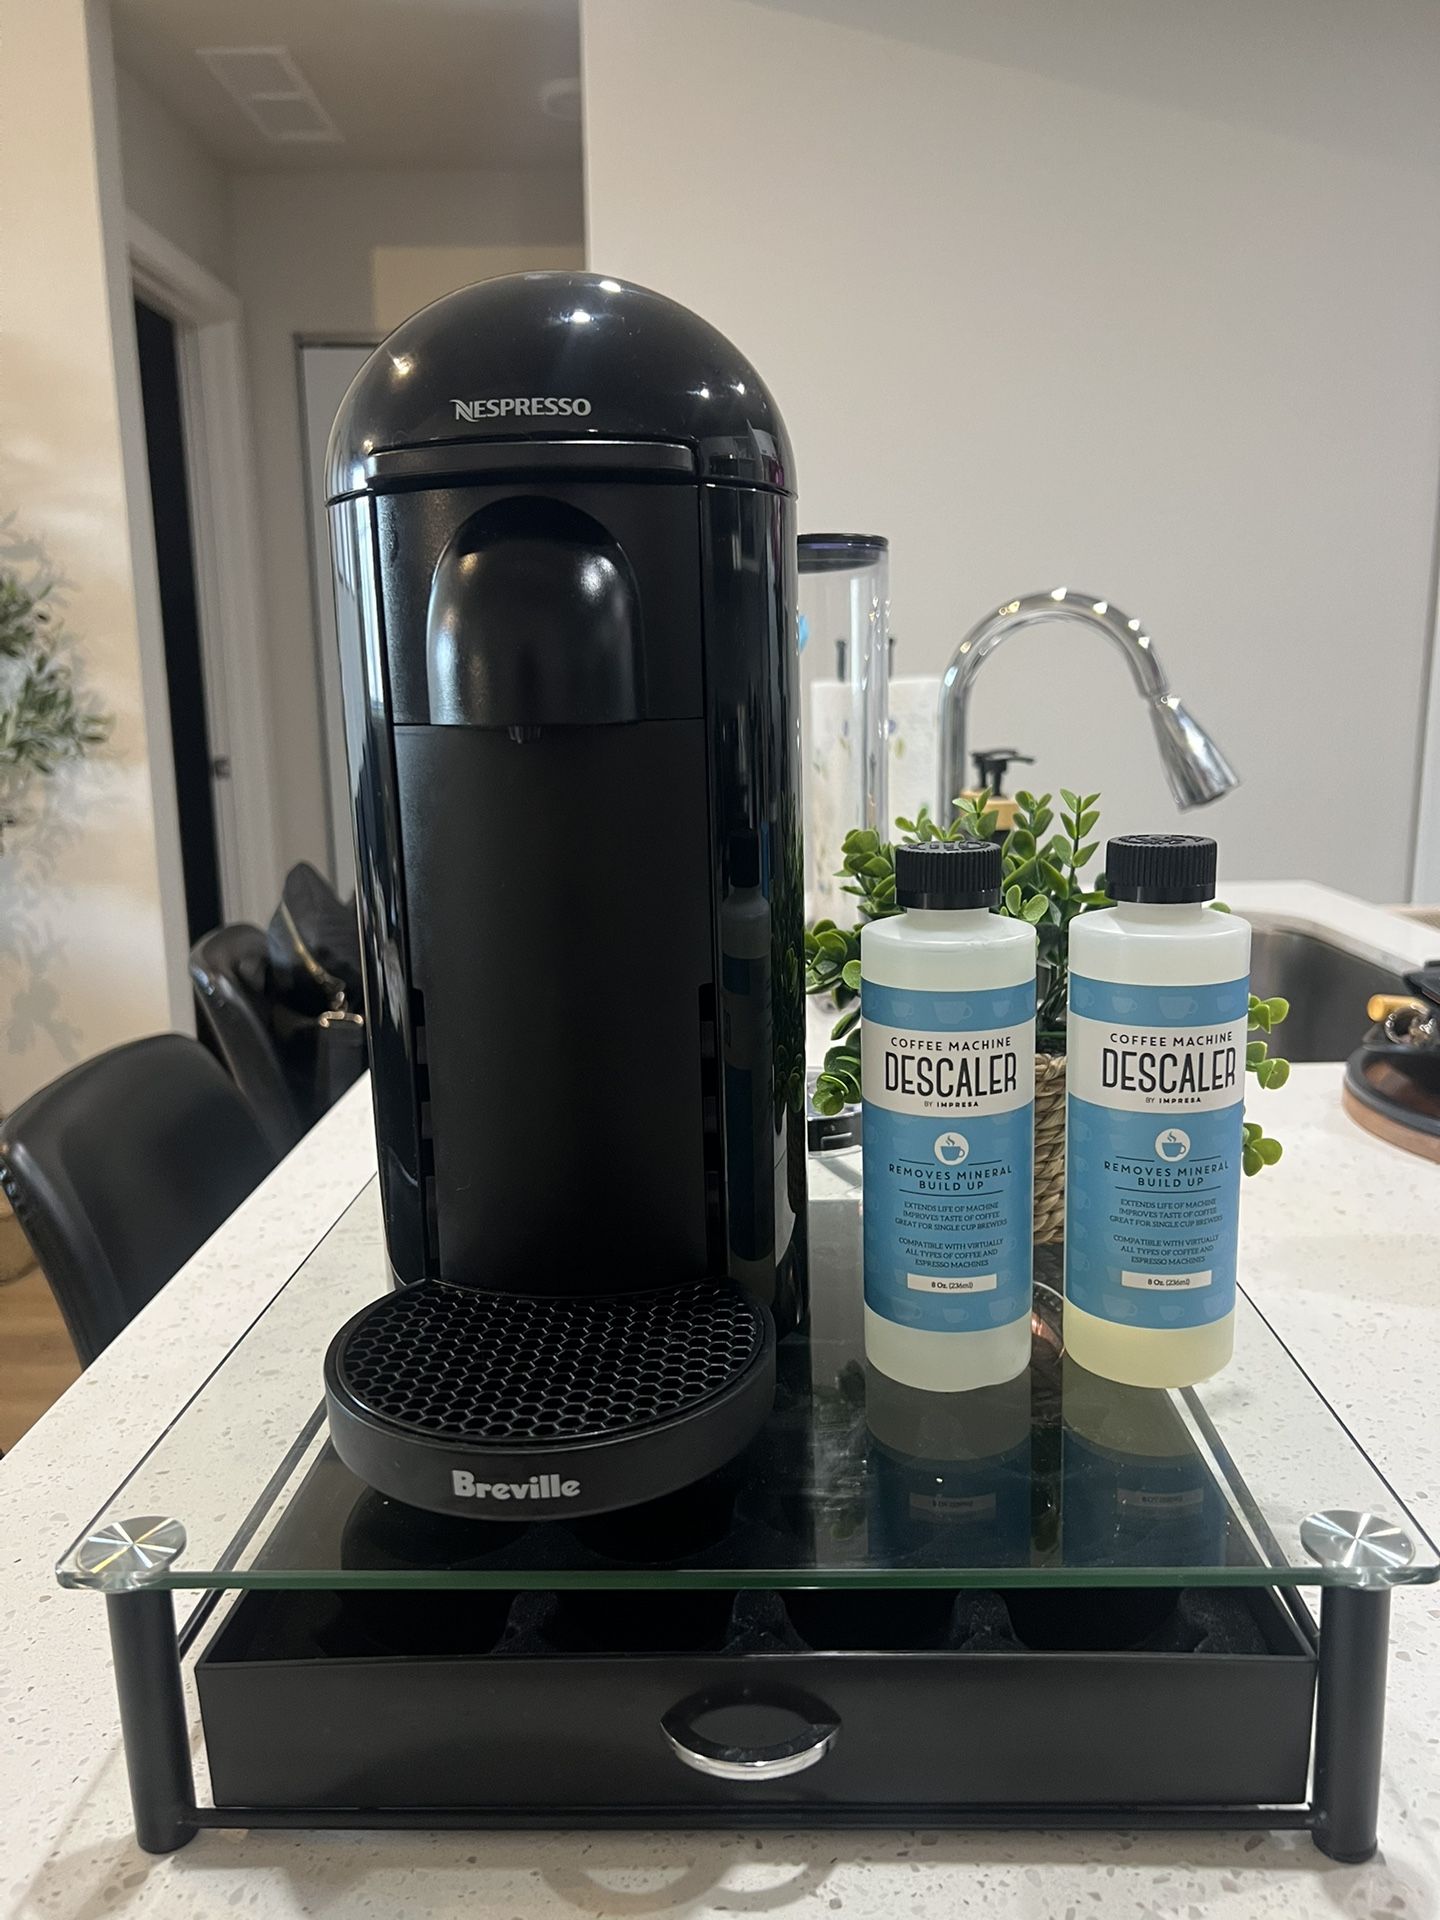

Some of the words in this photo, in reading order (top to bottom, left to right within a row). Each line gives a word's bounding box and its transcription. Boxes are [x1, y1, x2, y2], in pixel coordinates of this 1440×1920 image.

[449, 398, 591, 422] NESPRESSO
[891, 1037, 942, 1051] COFFEE
[948, 1037, 1011, 1051] MACHINE
[1110, 1033, 1167, 1047] COFFEE
[1173, 1031, 1232, 1047] MACHINE
[885, 1051, 1016, 1098] DESCALER
[1102, 1047, 1236, 1093] DESCALER
[889, 1164, 951, 1180] REMOVES
[957, 1165, 1012, 1180] MINERAL
[1104, 1161, 1171, 1177] REMOVES
[1177, 1161, 1228, 1177] MINERAL
[919, 1181, 961, 1191] BUILD
[967, 1181, 984, 1190] UP
[1138, 1178, 1180, 1188] BUILD
[1188, 1178, 1204, 1187] UP
[904, 1201, 936, 1212] EXTENDS
[966, 1202, 998, 1212] MACHINE
[1121, 1199, 1155, 1209] EXTENDS
[1186, 1198, 1216, 1208] MACHINE
[903, 1211, 939, 1221] IMPROVES
[941, 1214, 963, 1222] TASTE
[976, 1211, 999, 1221] COFFEE
[1119, 1208, 1158, 1218] IMPROVES
[1194, 1208, 1217, 1217] COFFEE
[895, 1217, 917, 1228] GREAT
[918, 1222, 932, 1230] FOR
[934, 1223, 959, 1231] SINGLE
[961, 1223, 976, 1231] CUP
[1109, 1215, 1133, 1225] GREAT
[1136, 1218, 1151, 1227] FOR
[1152, 1220, 1179, 1228] SINGLE
[1180, 1219, 1195, 1227] CUP
[898, 1237, 943, 1249] COMPATIBLE
[945, 1242, 965, 1250] WITH
[967, 1238, 1003, 1249] VIRTUALLY
[1163, 1239, 1183, 1247] WITH
[1185, 1234, 1219, 1246] VIRTUALLY
[906, 1248, 918, 1256] ALL
[920, 1250, 942, 1258] TYPES
[954, 1250, 982, 1258] COFFEE
[982, 1248, 998, 1256] AND
[1121, 1245, 1134, 1253] ALL
[1172, 1247, 1198, 1256] COFFEE
[1198, 1245, 1214, 1254] AND
[915, 1259, 949, 1268] ESPRESSO
[951, 1260, 989, 1268] MACHINES
[1131, 1256, 1167, 1265] ESPRESSO
[1168, 1256, 1205, 1265] MACHINES
[452, 1469, 580, 1500] Breville
